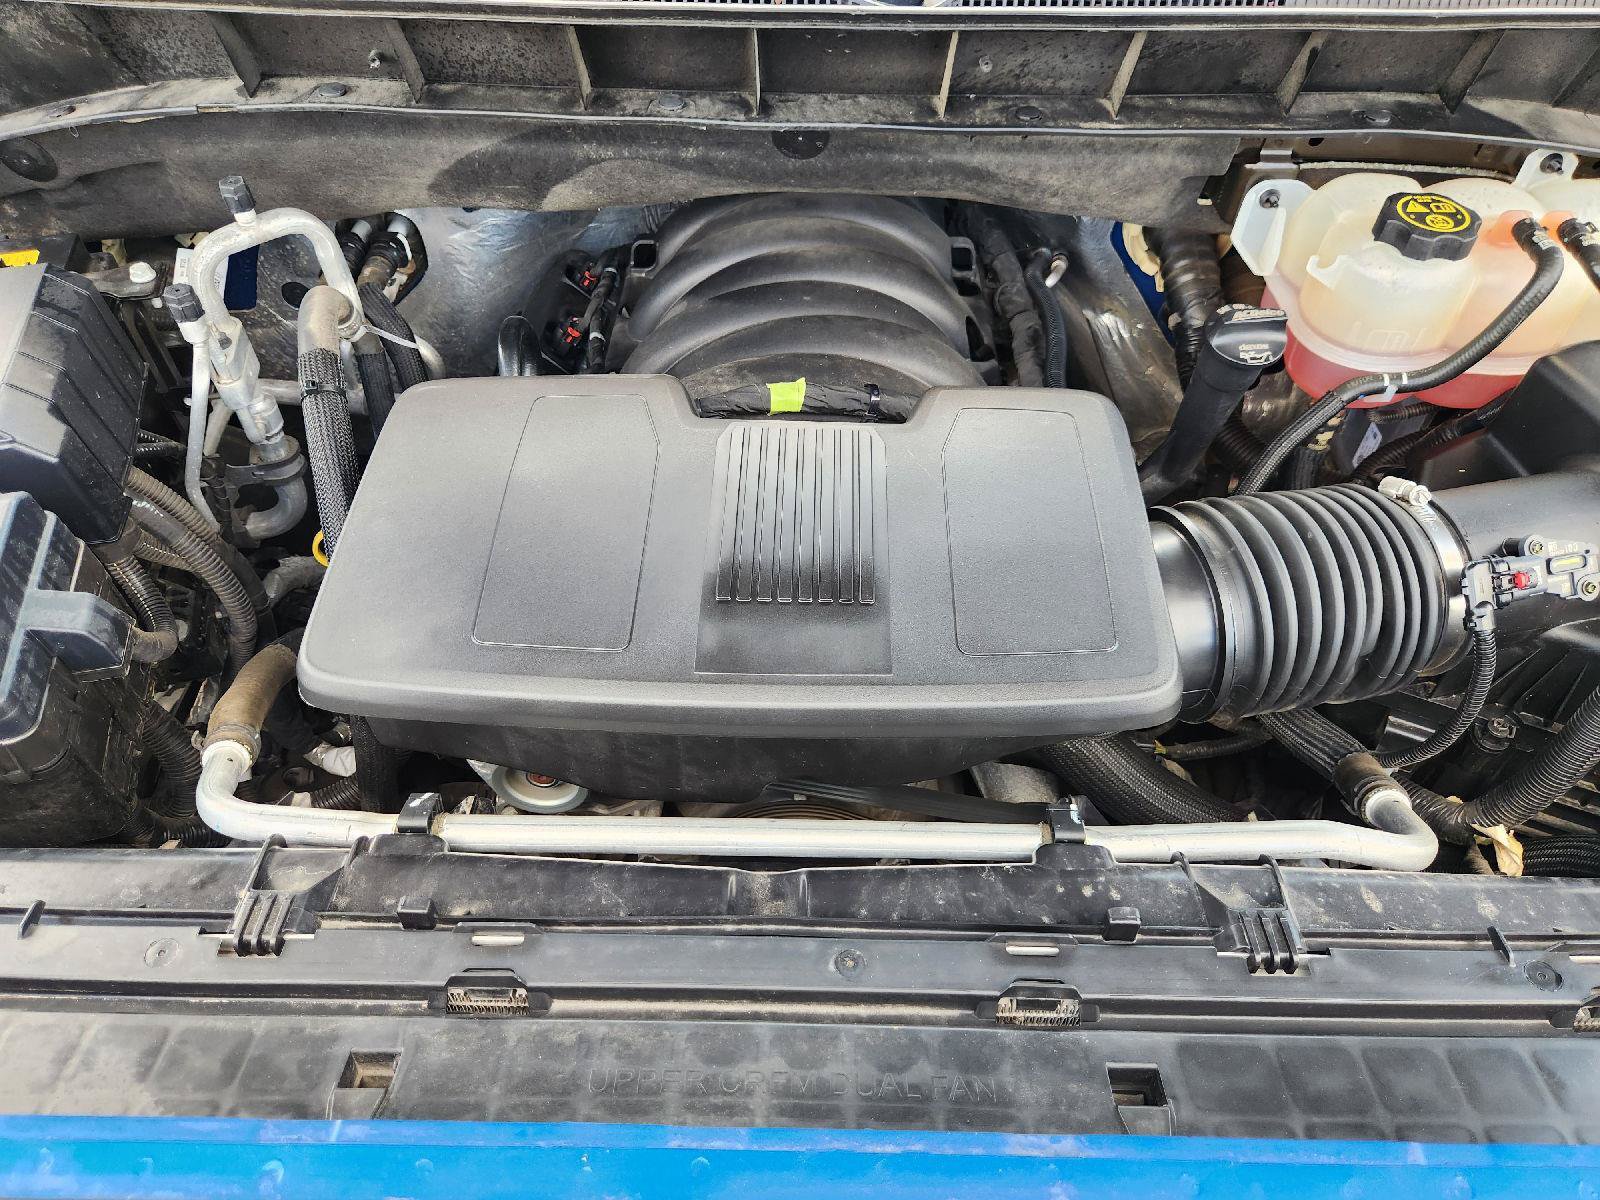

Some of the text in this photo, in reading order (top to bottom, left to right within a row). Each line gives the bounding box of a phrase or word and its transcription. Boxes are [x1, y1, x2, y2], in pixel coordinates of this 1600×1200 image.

[588, 1067, 709, 1095] UPPER
[831, 1072, 922, 1099] DUAL
[929, 1074, 997, 1102] FAN
